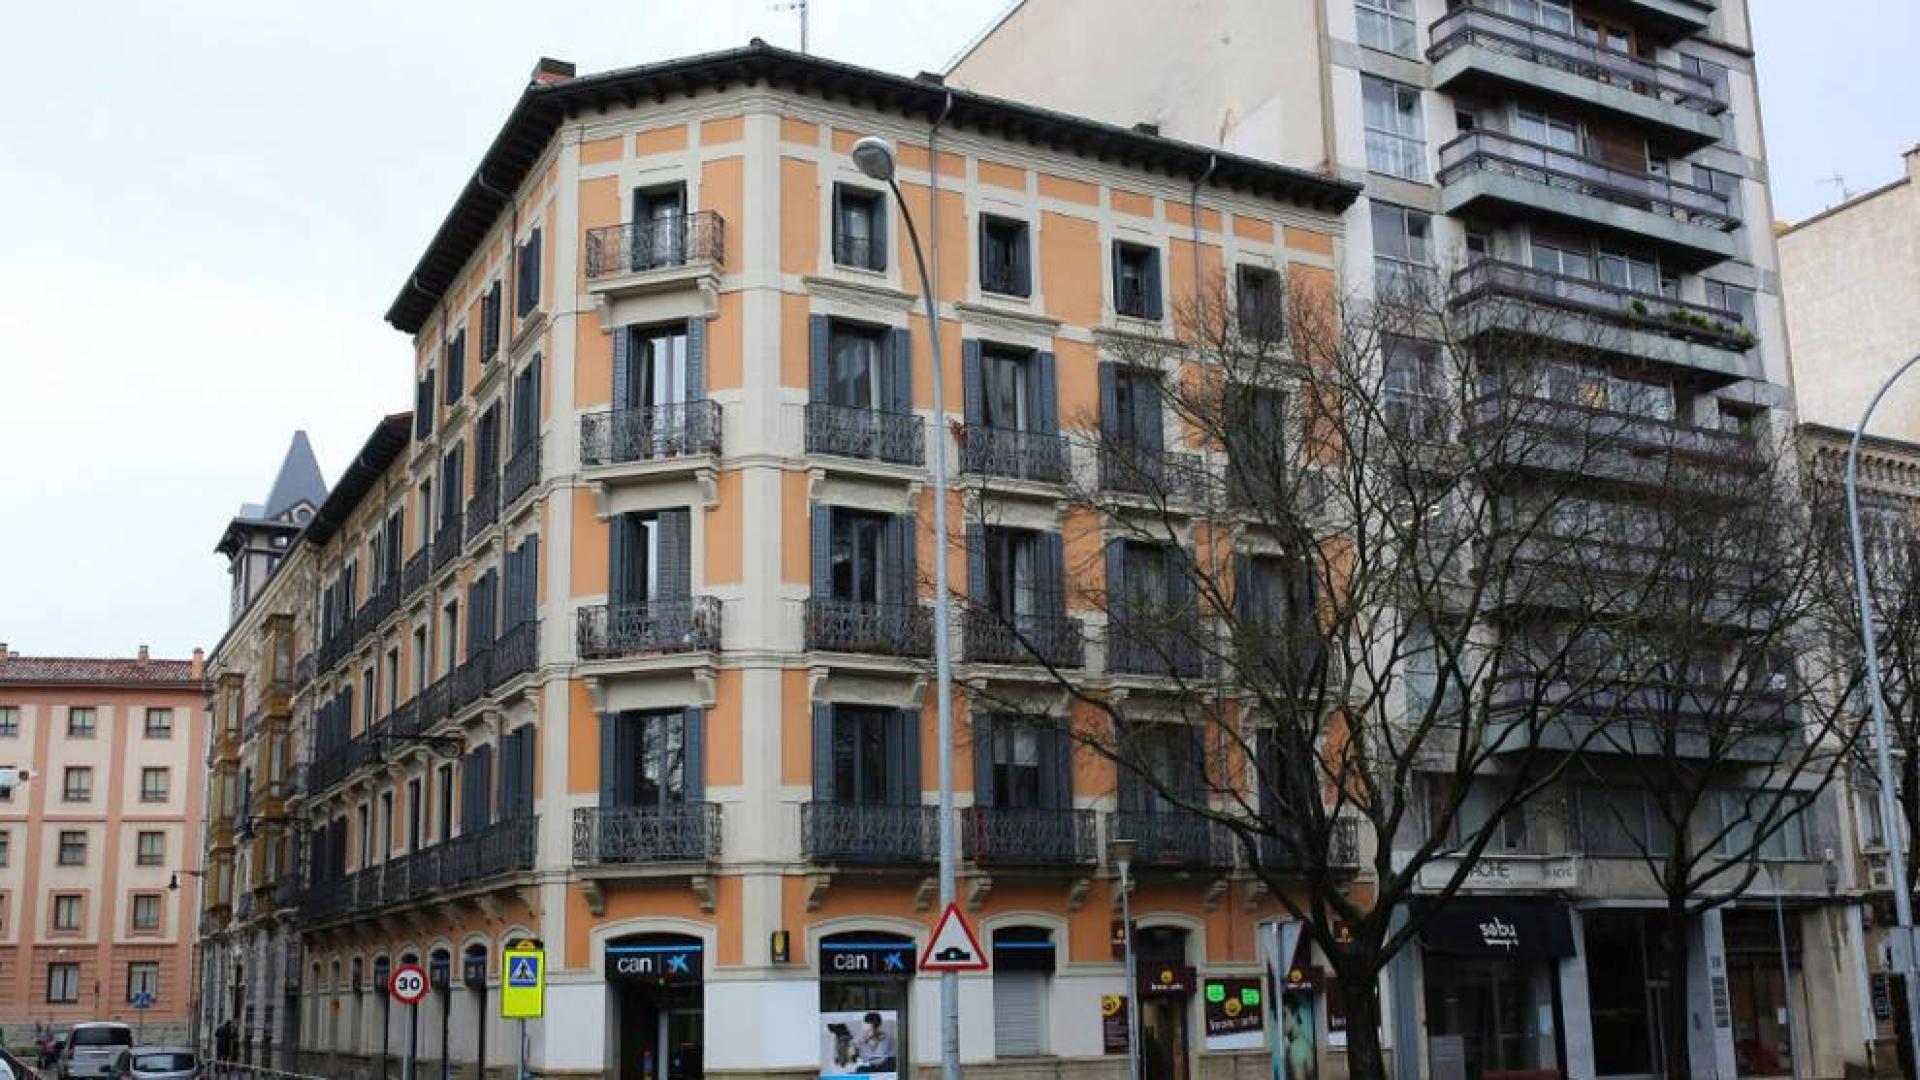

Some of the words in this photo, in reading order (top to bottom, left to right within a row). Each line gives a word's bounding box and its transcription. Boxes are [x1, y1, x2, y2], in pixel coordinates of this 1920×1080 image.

[617, 957, 653, 973] can
[833, 953, 869, 970] can
[398, 977, 420, 991] 30
